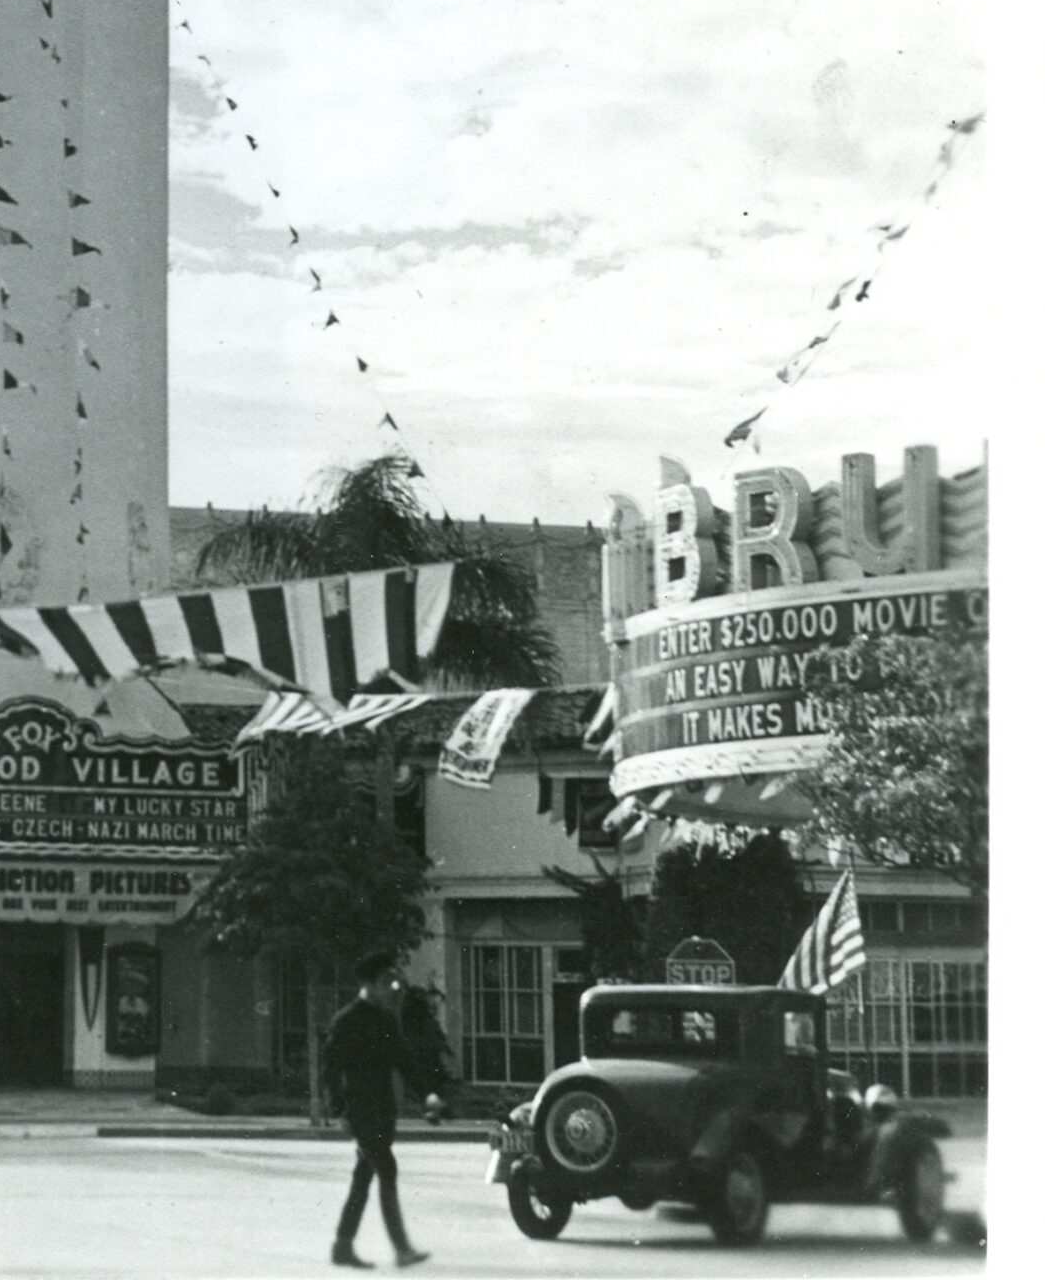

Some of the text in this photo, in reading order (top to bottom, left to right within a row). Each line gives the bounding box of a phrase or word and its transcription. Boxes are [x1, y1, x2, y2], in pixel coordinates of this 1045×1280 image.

[659, 622, 712, 659] ENTER
[853, 595, 948, 632] MOVIE
[666, 669, 687, 702] AN
[694, 660, 745, 696] EASY
[757, 654, 807, 689] WAY
[3, 721, 61, 752] FOX
[683, 711, 700, 744] IT
[708, 703, 782, 740] MAKES
[72, 758, 220, 786] VILLAGE
[94, 797, 118, 815] MY
[124, 797, 184, 816] LUCKY
[190, 800, 237, 818] STAR
[137, 823, 197, 842] MARCH
[205, 824, 245, 843] TIME
[669, 964, 732, 985] STOP
